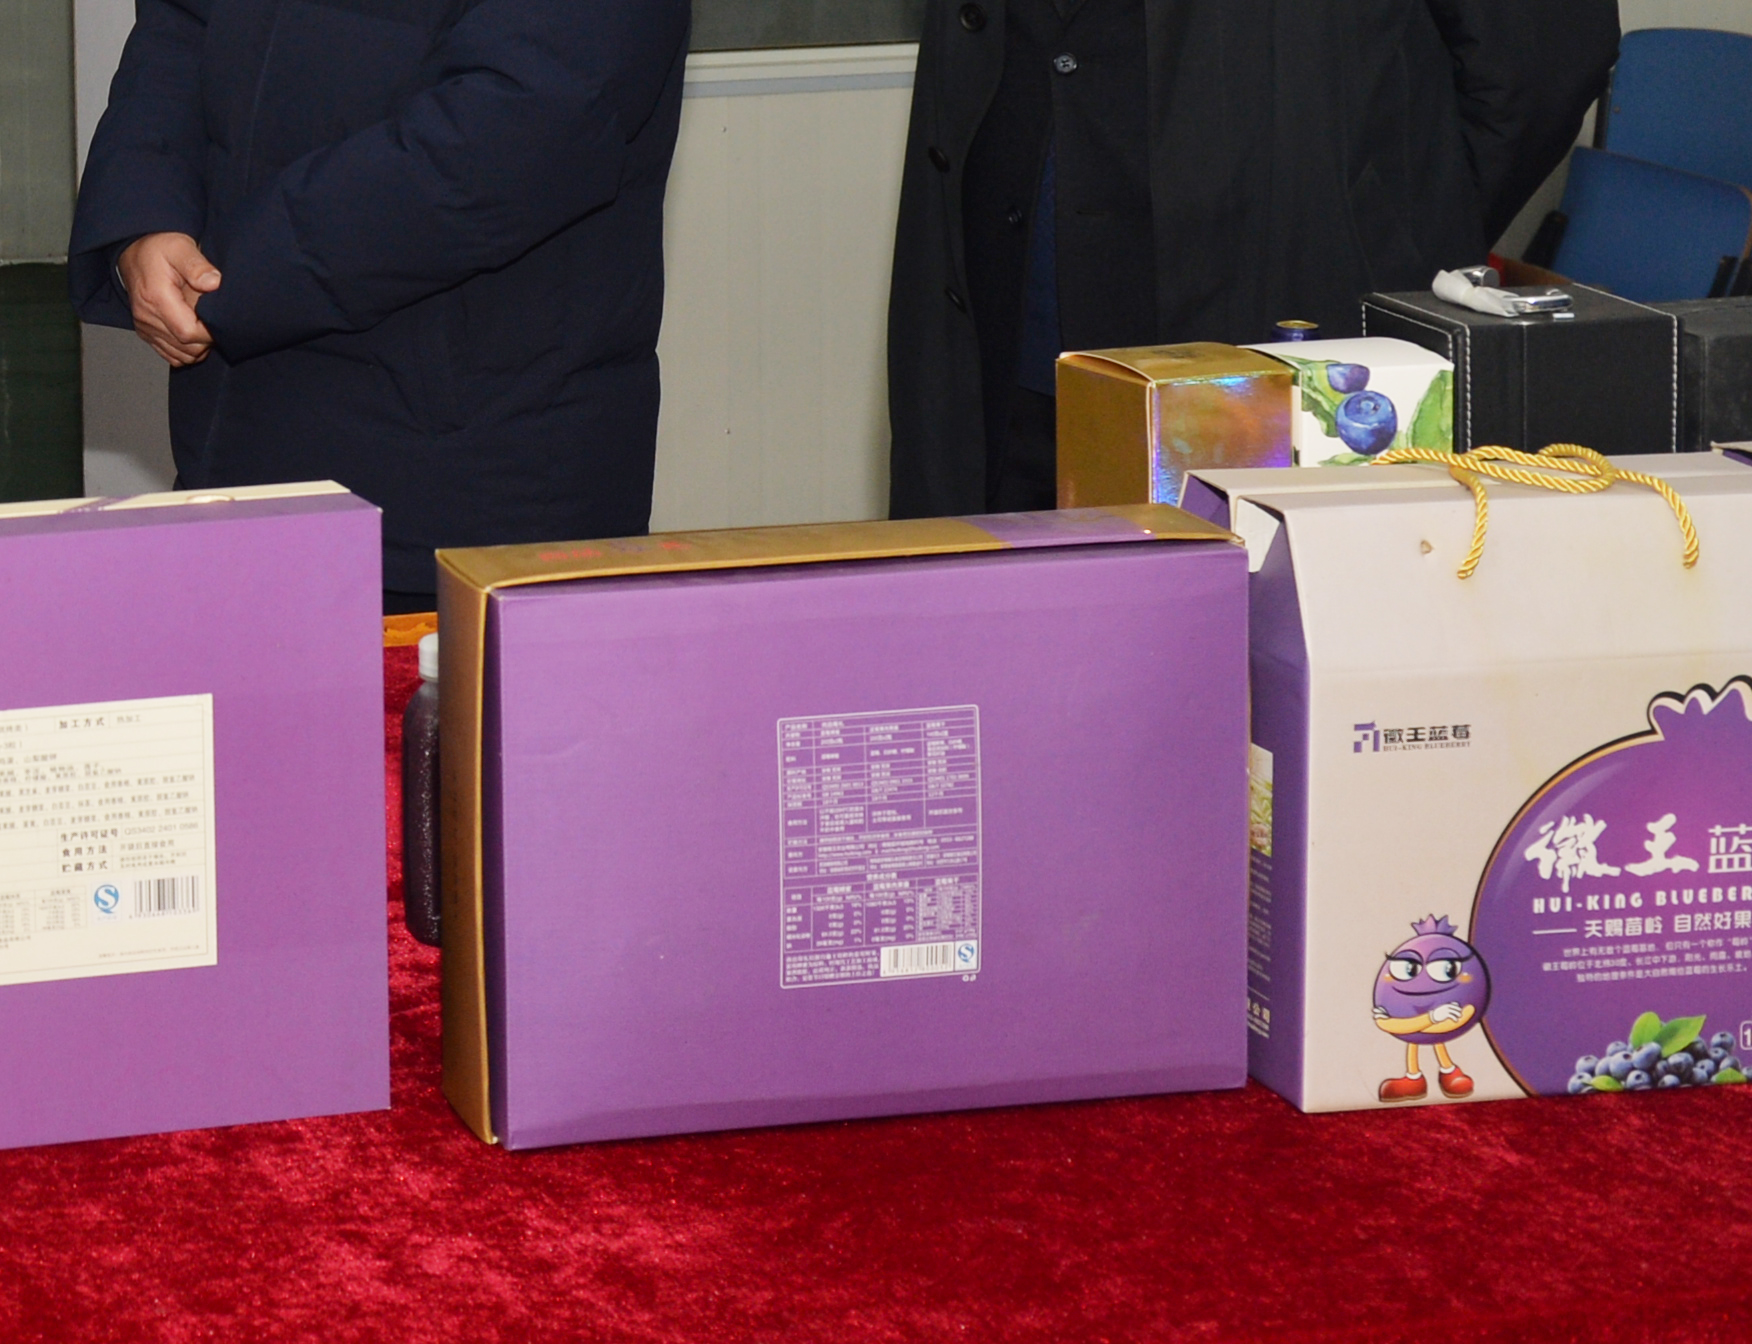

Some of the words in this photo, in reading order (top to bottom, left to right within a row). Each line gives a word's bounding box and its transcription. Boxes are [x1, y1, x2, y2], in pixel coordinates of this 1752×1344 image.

[59, 717, 105, 729] 加工方式
[60, 828, 118, 842] 生产许可证号
[1533, 892, 1643, 914] HUI-KING
